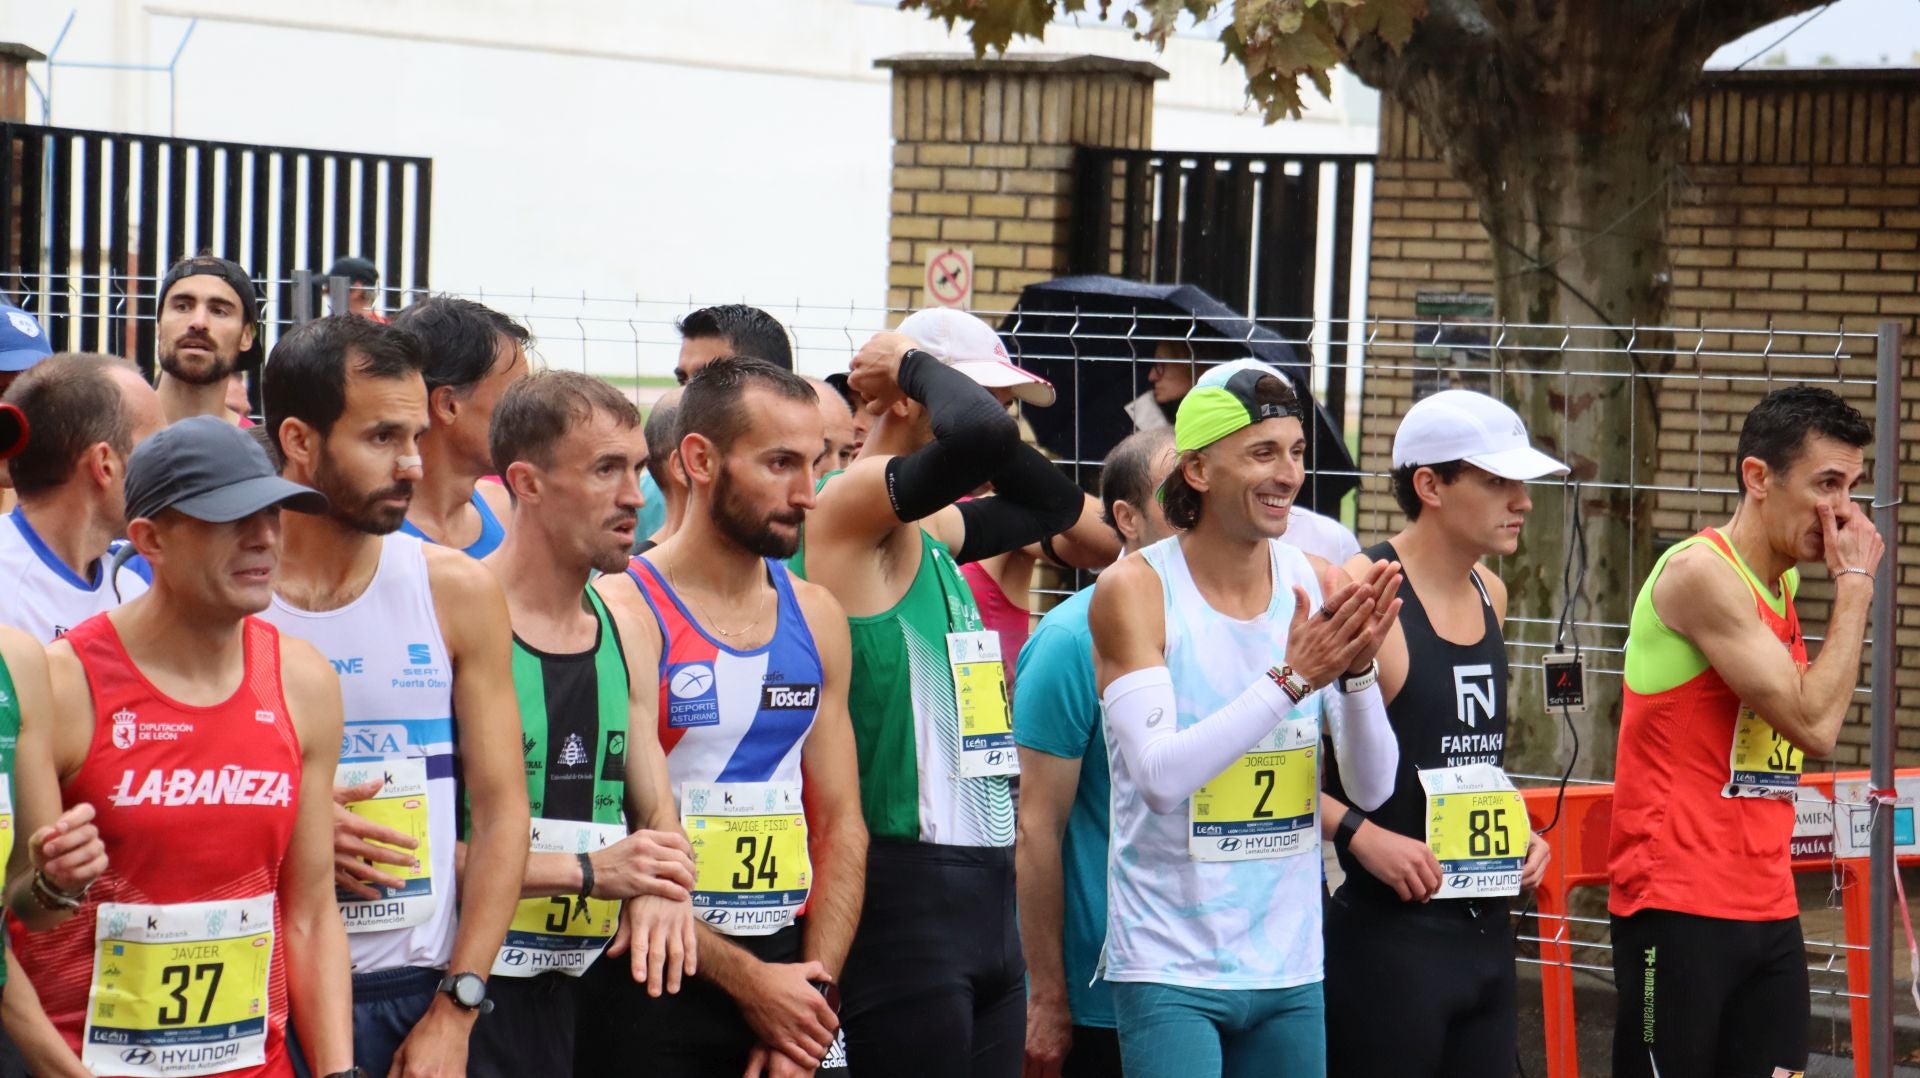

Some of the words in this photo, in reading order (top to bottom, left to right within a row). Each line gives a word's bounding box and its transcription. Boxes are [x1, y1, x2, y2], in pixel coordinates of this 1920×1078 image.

[977, 640, 984, 651] k
[402, 668, 440, 676] SEAT
[391, 679, 425, 689] Puerta
[767, 687, 815, 707] Toscaf
[671, 702, 716, 714] DEPORTE
[671, 712, 718, 723] ASTURIANO
[139, 722, 194, 733] DIPUTACIÓN
[1296, 728, 1302, 739] k
[139, 732, 151, 741] DE
[153, 730, 178, 741] LEÓN
[1245, 755, 1286, 767] JORGITO
[384, 771, 394, 784] k
[724, 792, 733, 805] k
[1253, 770, 1275, 818] 2
[1469, 809, 1510, 857] 85
[1245, 833, 1300, 849] HYUNDAI
[732, 836, 778, 890] 34
[147, 915, 158, 931] k
[240, 910, 249, 924] k
[356, 916, 405, 927] Automoción
[735, 909, 791, 924] HYUNDAI
[171, 945, 220, 961] JAVIER
[531, 952, 585, 967] HYUNDAI
[157, 963, 224, 1026] 37
[161, 1043, 240, 1064] HYUNDAI
